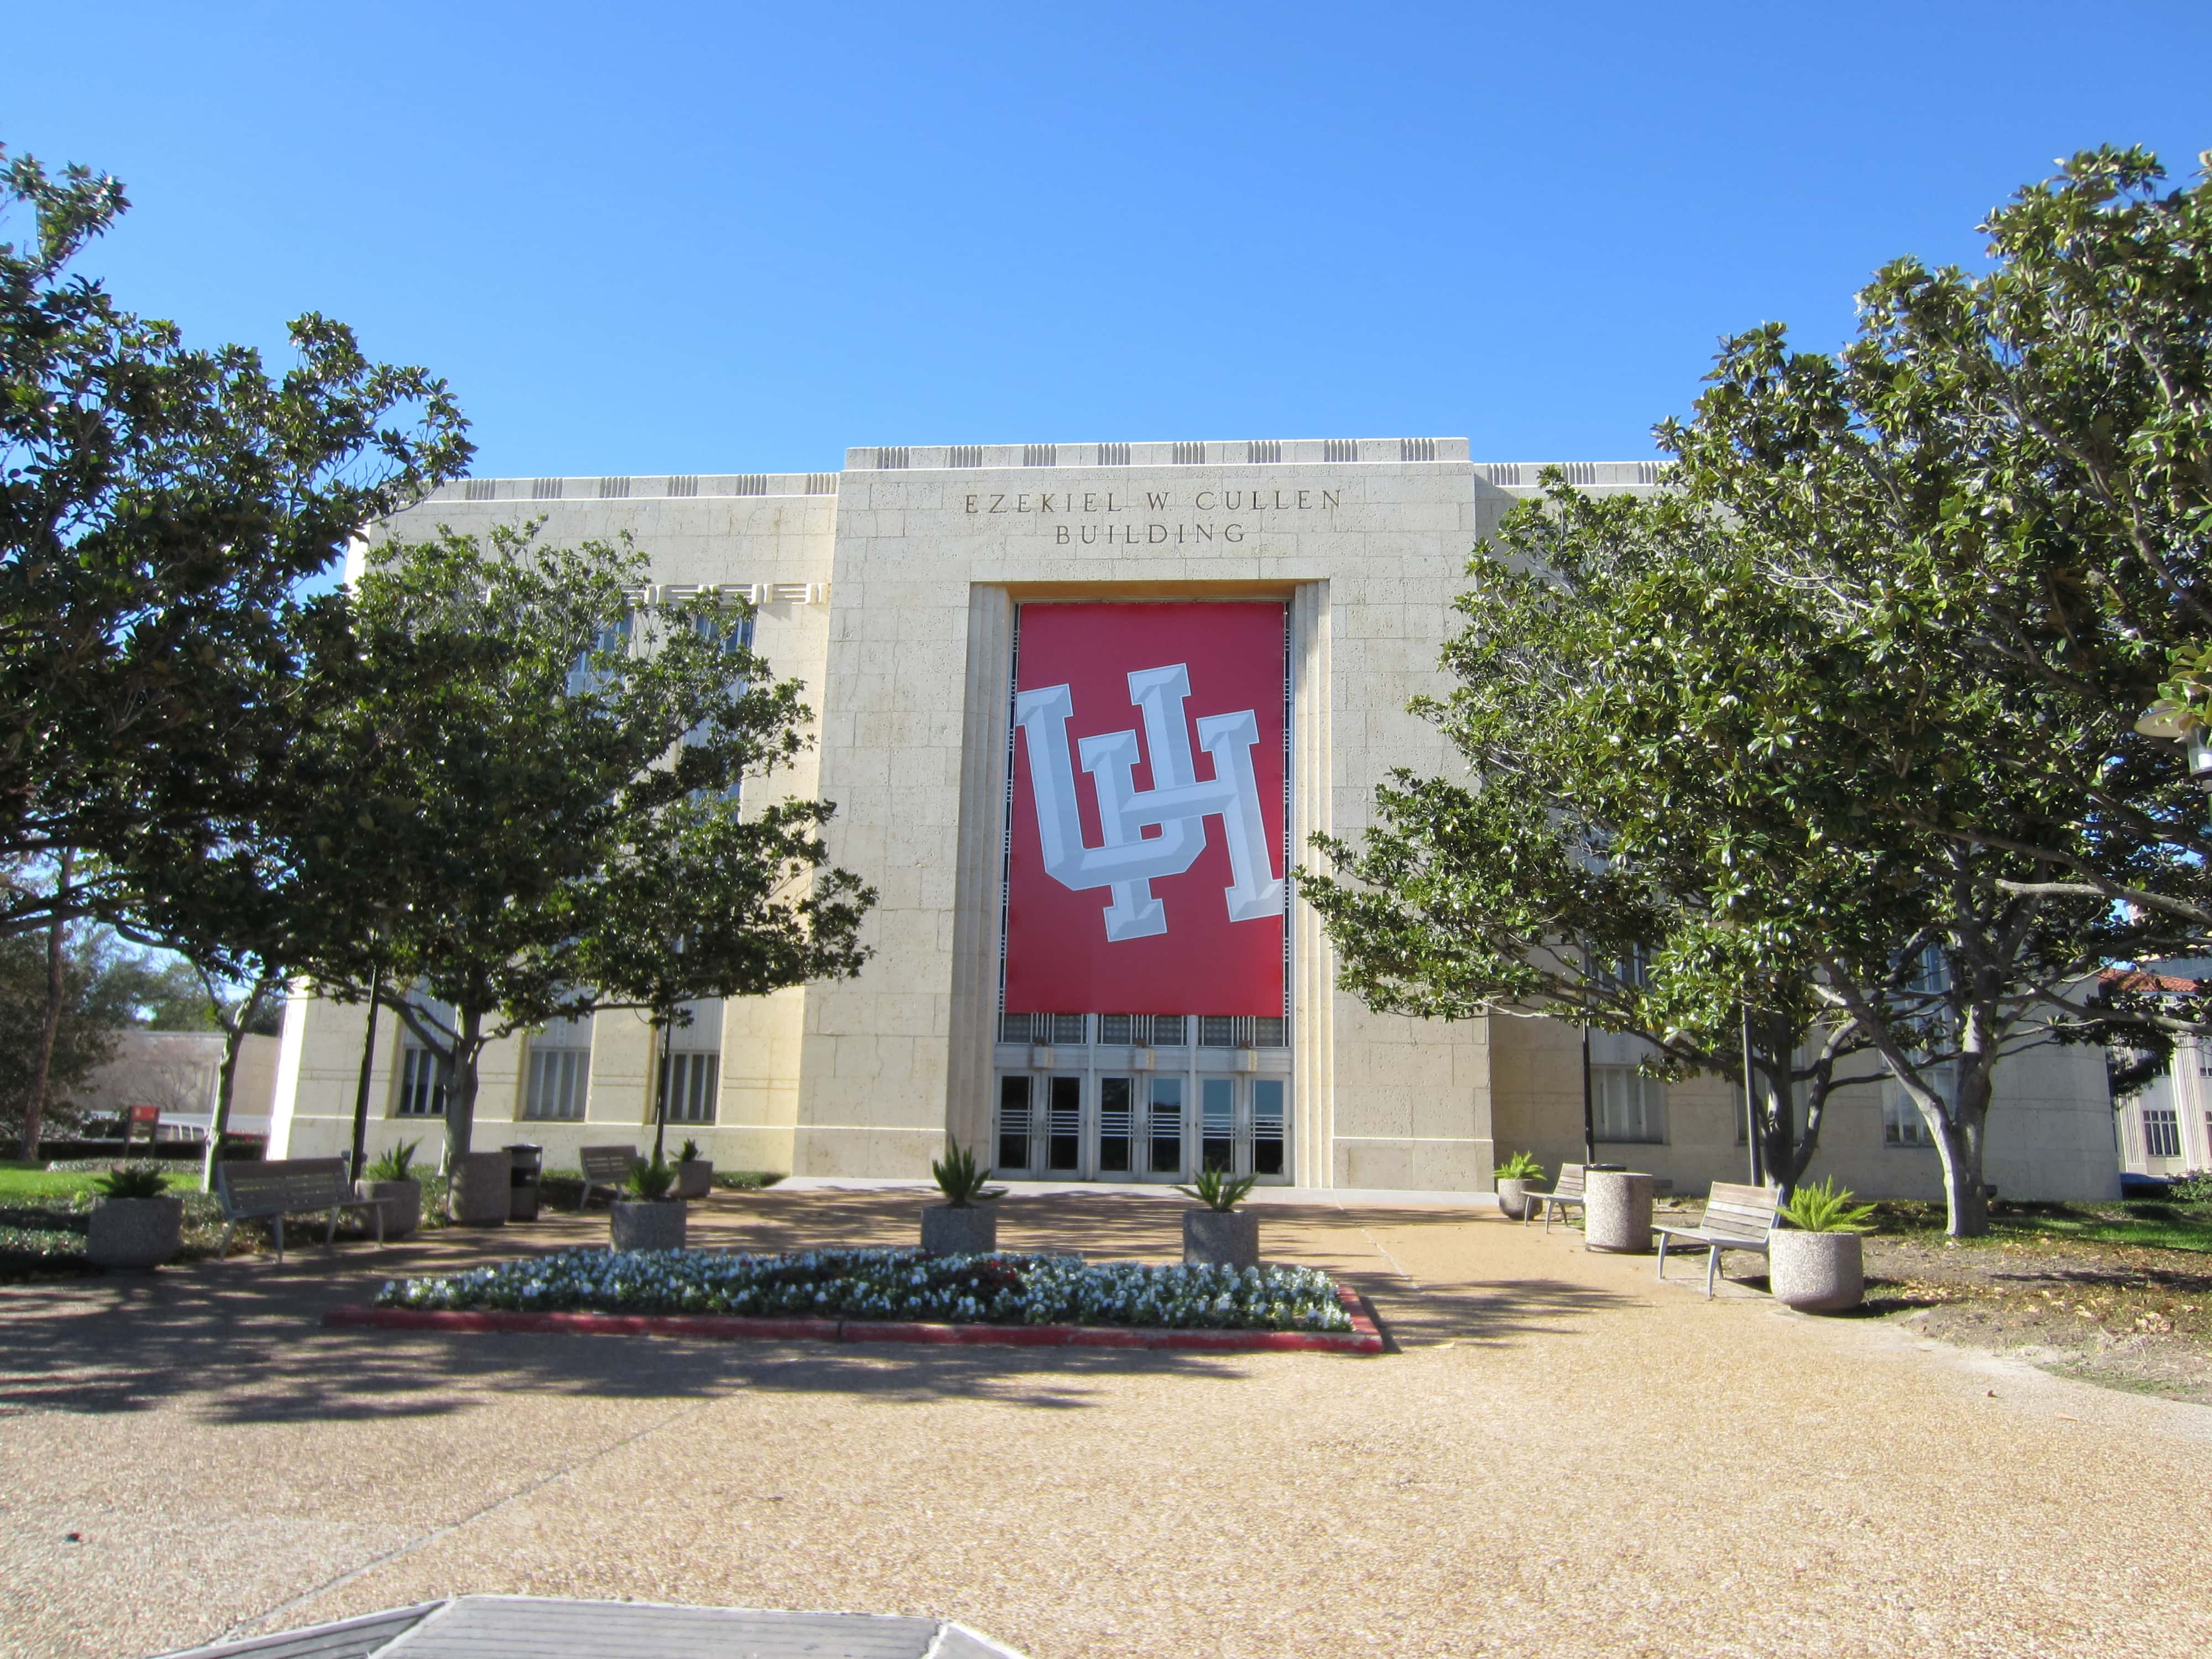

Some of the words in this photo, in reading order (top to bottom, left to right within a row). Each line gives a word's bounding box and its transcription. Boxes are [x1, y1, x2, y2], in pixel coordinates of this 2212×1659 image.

[965, 493, 1121, 514] EZEKIEL
[1146, 492, 1169, 511] W
[1196, 490, 1342, 510] CULLEN
[1056, 524, 1245, 545] BUILDING
[1016, 663, 1284, 942] UH
